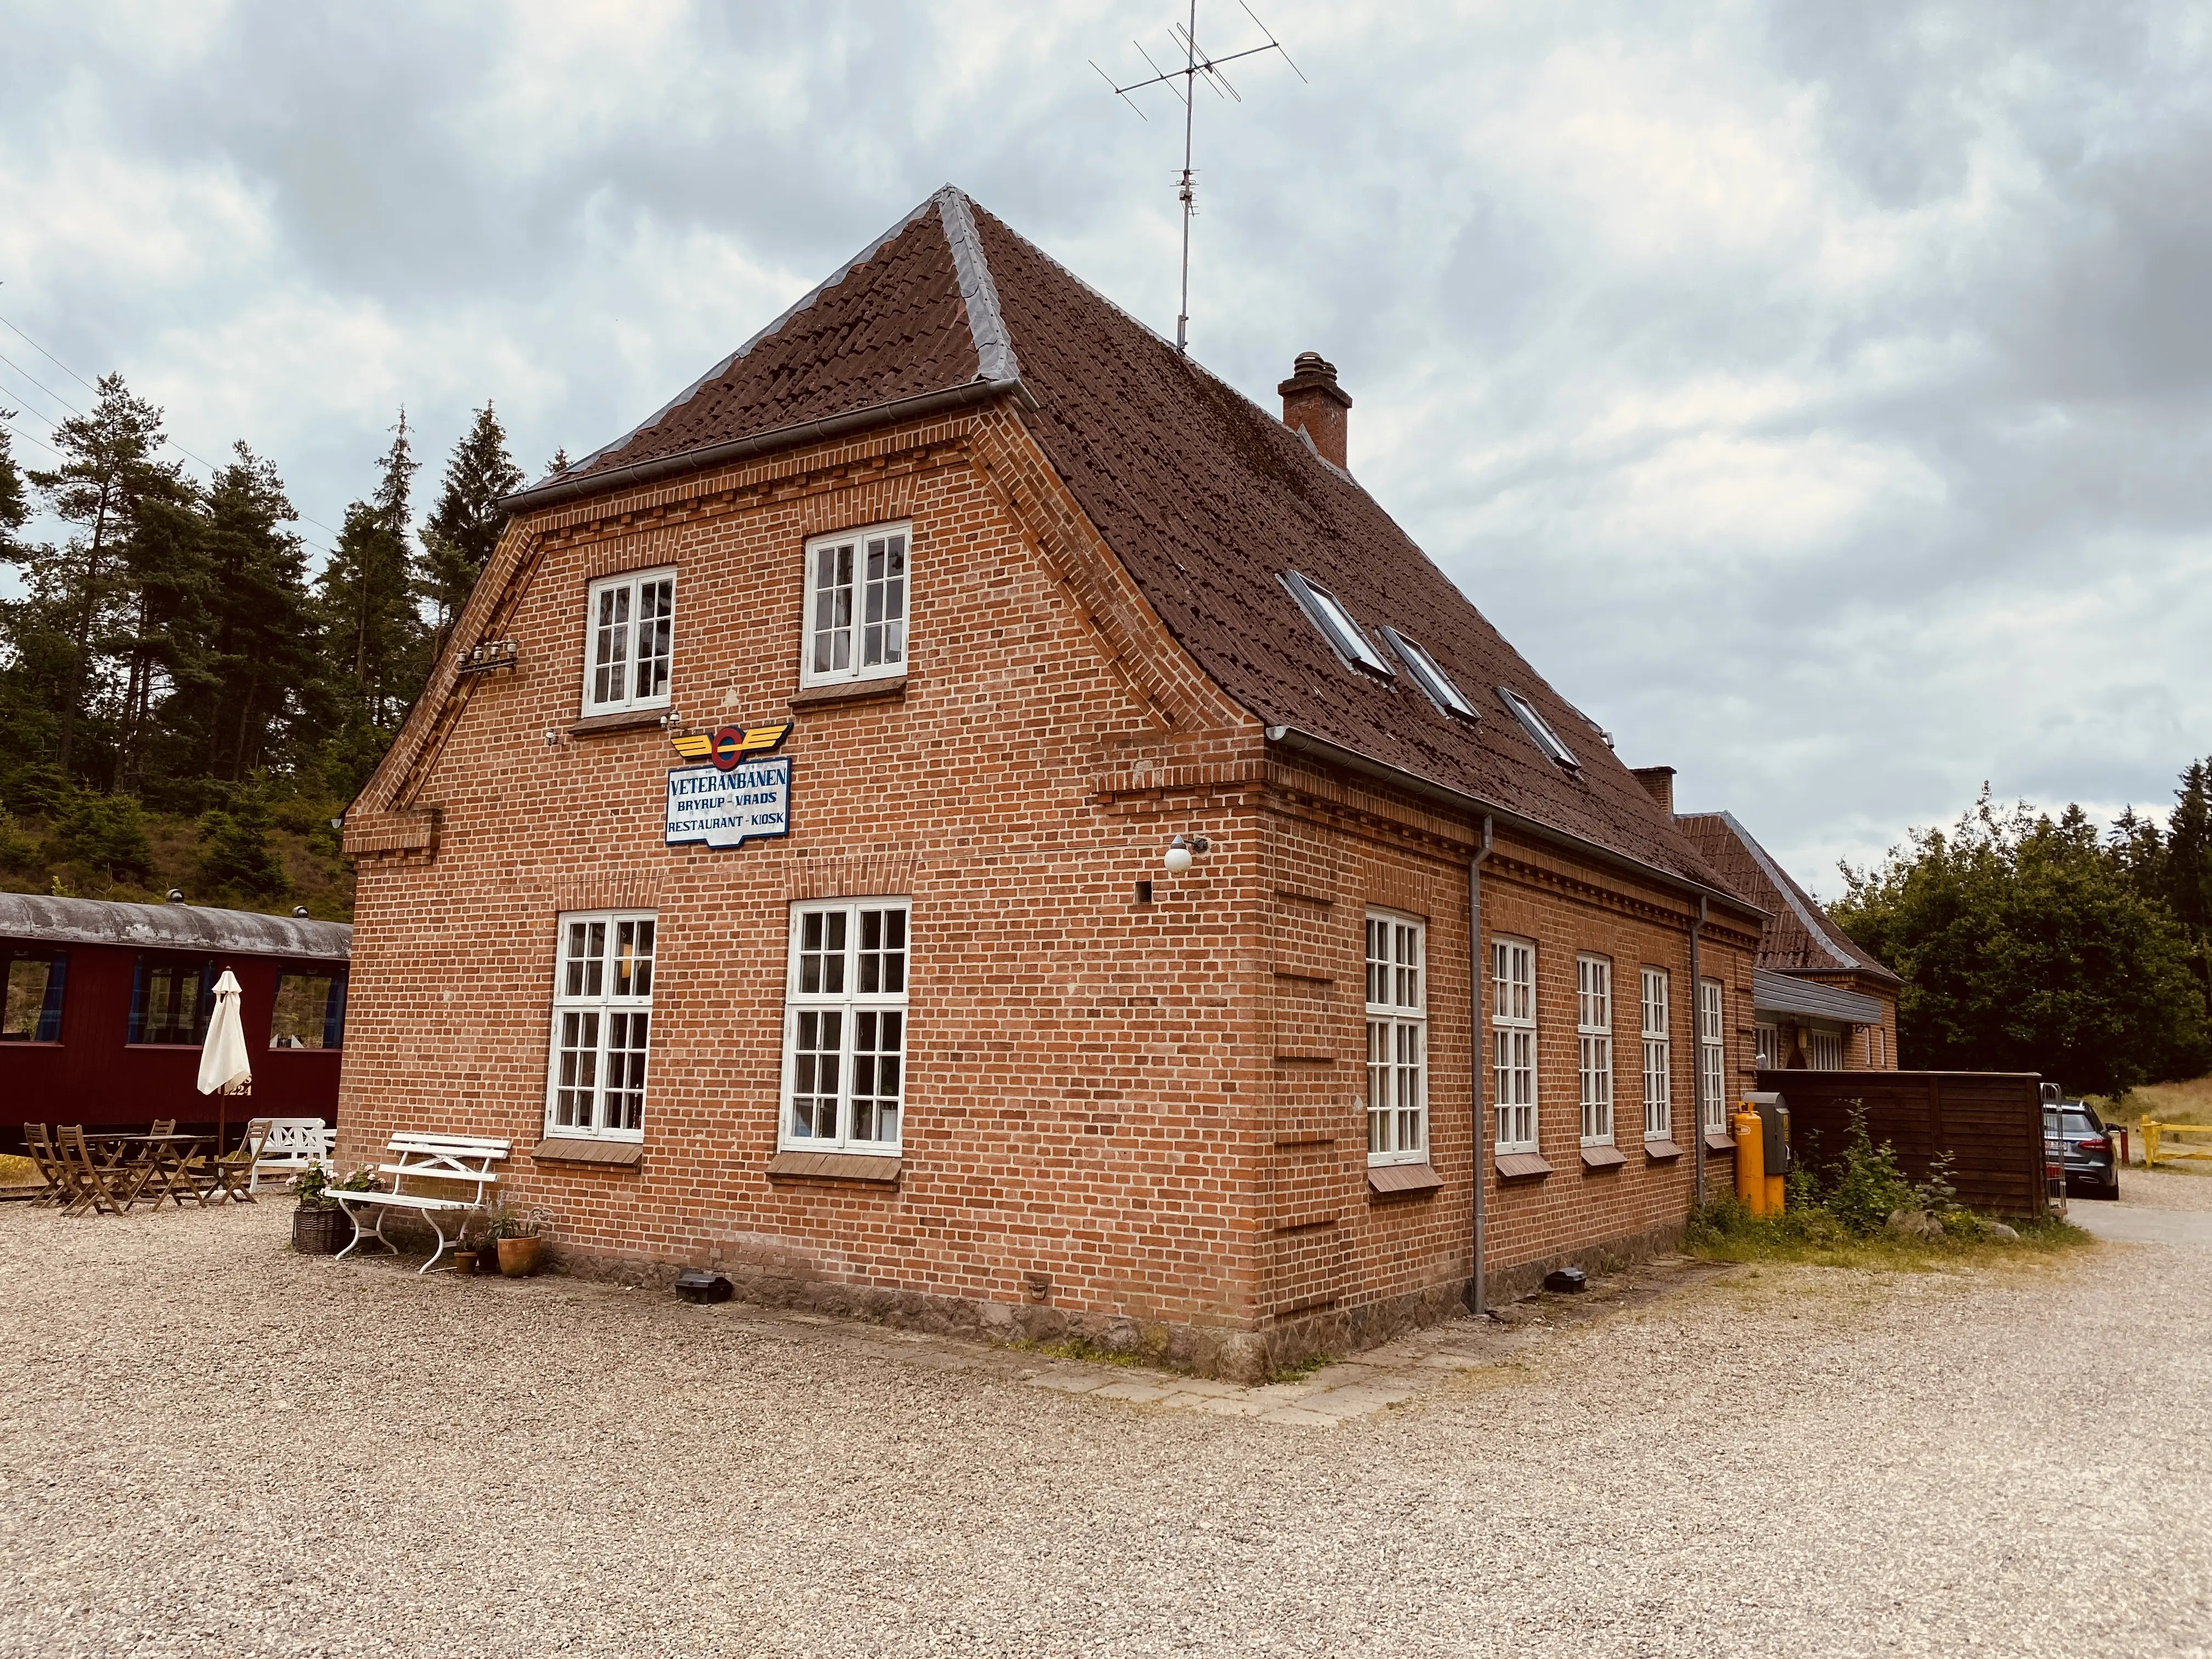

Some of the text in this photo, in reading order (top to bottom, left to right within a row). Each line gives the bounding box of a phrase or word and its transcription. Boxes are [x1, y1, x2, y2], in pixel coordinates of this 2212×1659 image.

[671, 768, 786, 796] VETERANBANEN
[678, 797, 725, 811] BRYRUP
[736, 792, 777, 806] VRADS
[668, 816, 743, 832] RESTAURANT
[751, 812, 785, 826] KIOSK
[224, 1085, 252, 1096] 224
